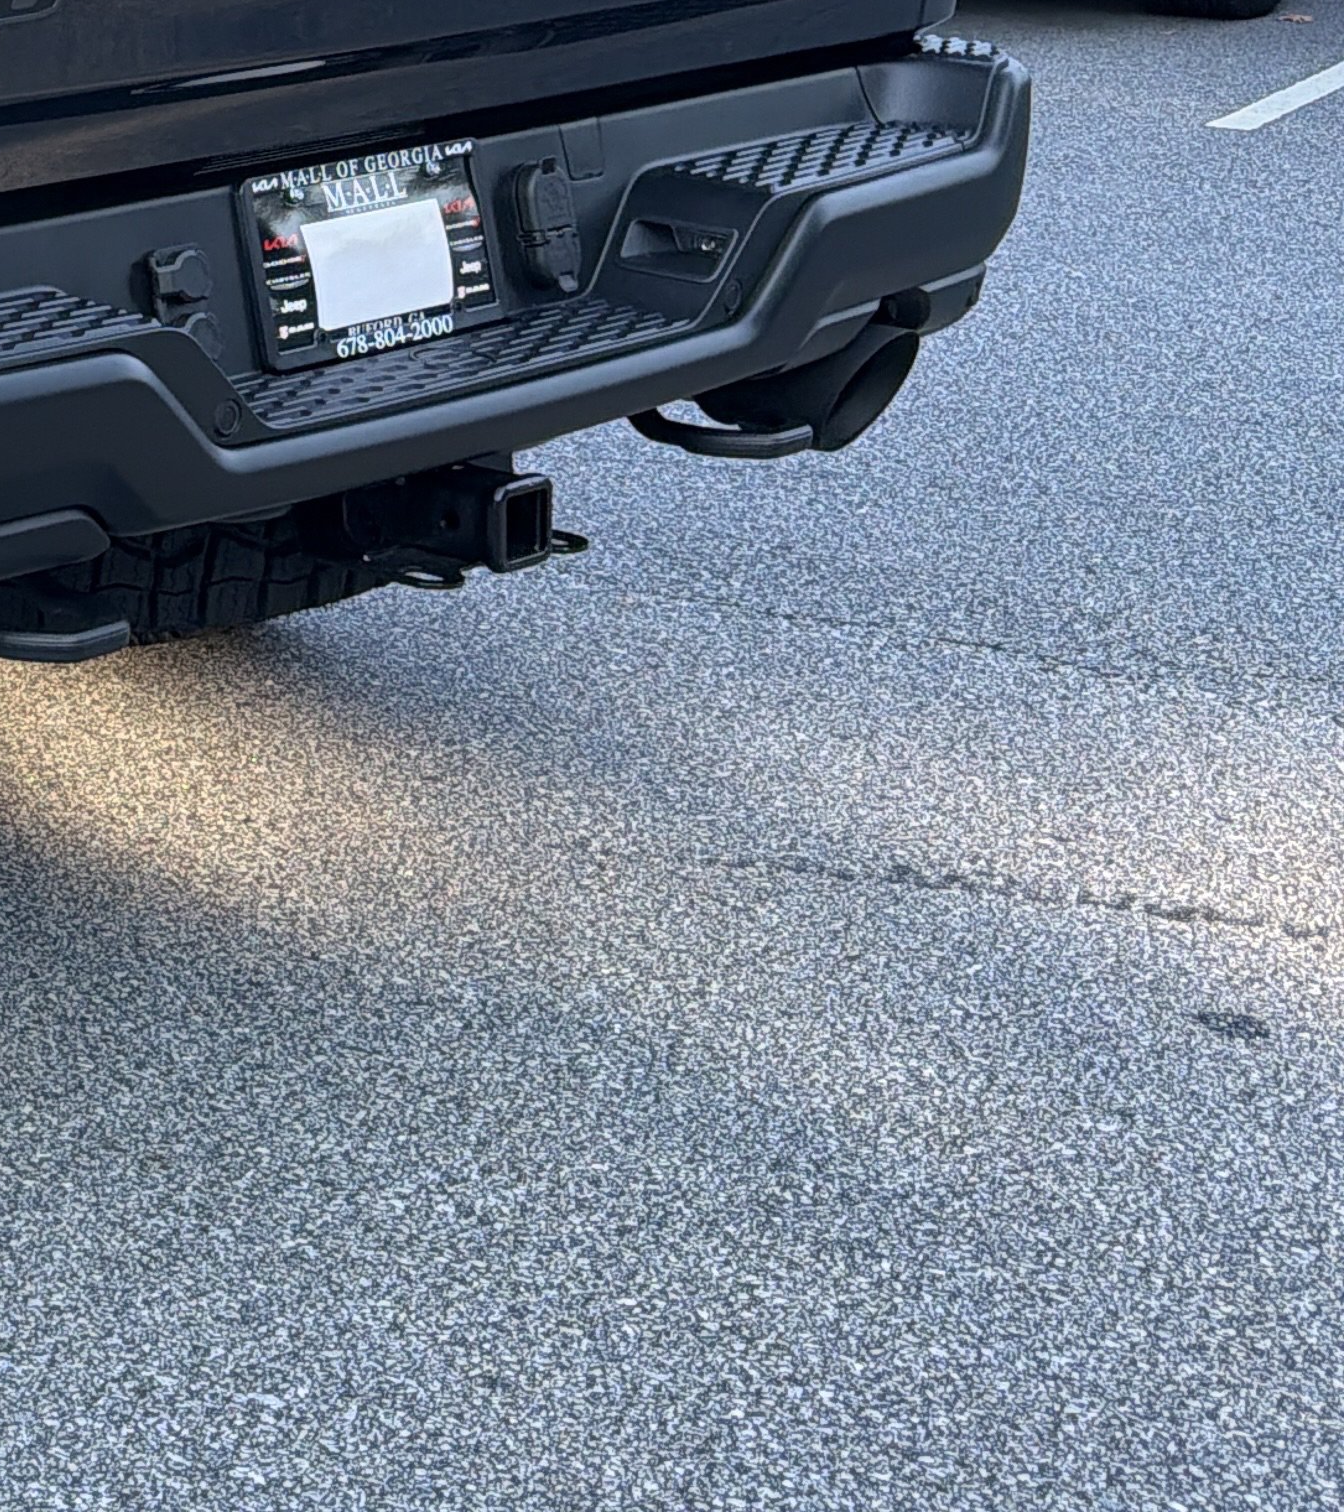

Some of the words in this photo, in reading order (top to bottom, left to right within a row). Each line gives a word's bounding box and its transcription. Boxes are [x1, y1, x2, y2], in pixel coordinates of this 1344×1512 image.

[336, 159, 360, 178] OF
[363, 146, 444, 173] GEORGIA
[336, 313, 454, 358] 678-804-2000
